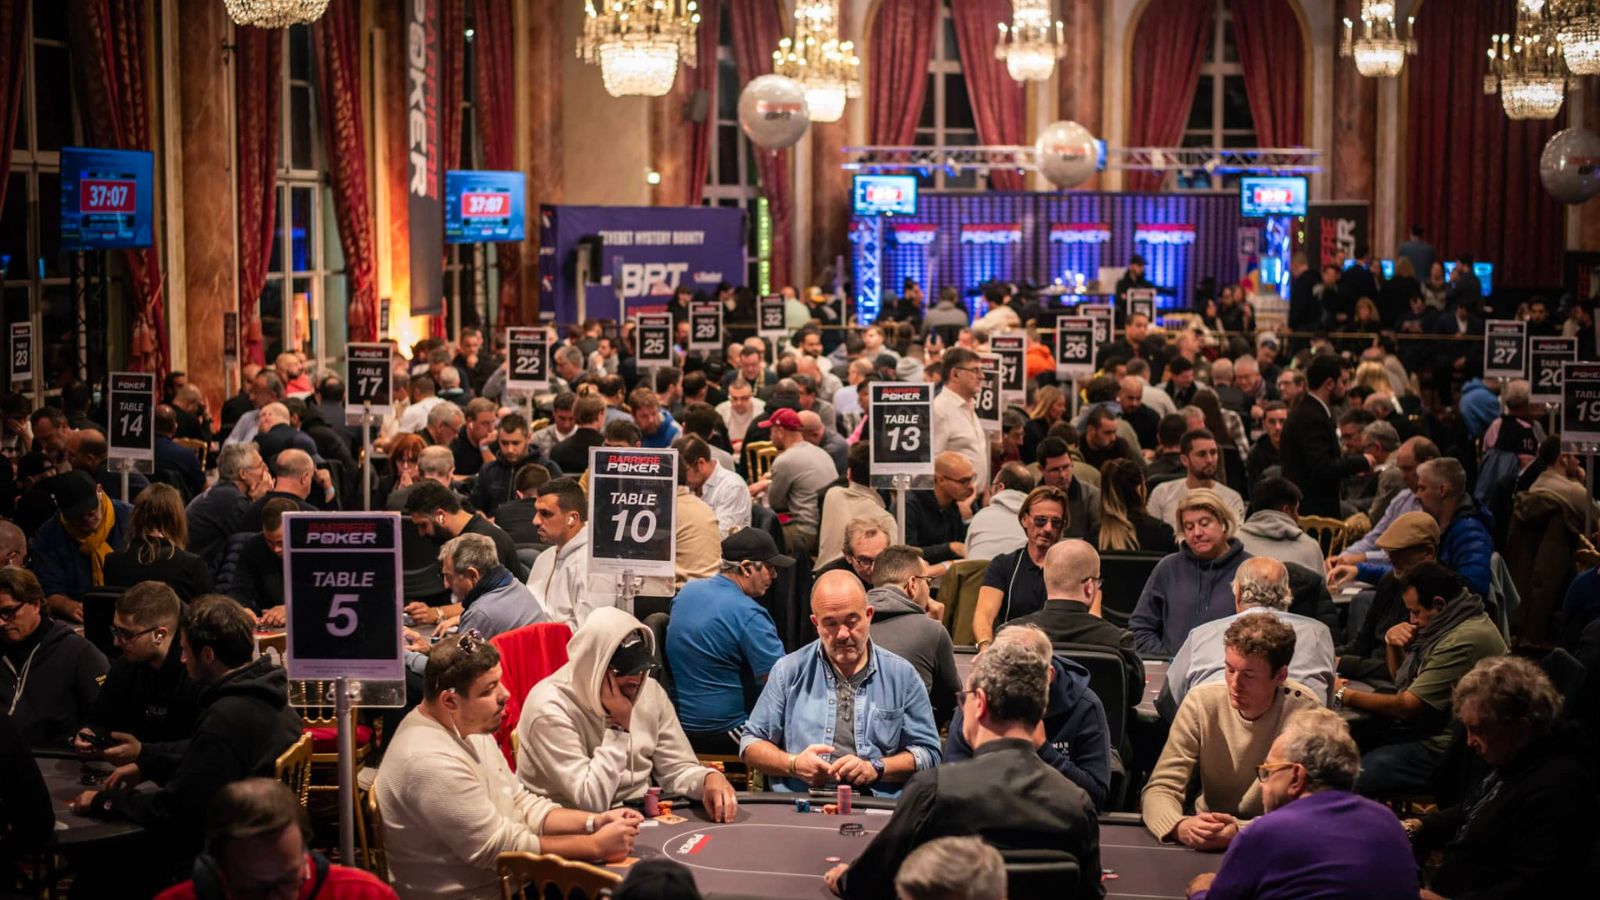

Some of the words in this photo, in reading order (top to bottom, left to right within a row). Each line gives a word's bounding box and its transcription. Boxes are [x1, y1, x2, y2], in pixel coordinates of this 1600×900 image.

[90, 185, 128, 208] 37:07
[696, 325, 716, 338] 29
[516, 348, 539, 356] TABLE
[644, 340, 665, 354] 25
[1064, 343, 1088, 358] 26
[15, 350, 28, 367] 23
[1492, 348, 1518, 364] 27
[356, 367, 382, 376] TABLE
[515, 357, 540, 374] 22
[1572, 371, 1600, 379] POKE
[117, 381, 146, 390] POKER
[358, 377, 383, 397] 17
[880, 392, 921, 401] POKER
[974, 389, 994, 411] 18
[1575, 389, 1600, 399] TABL
[119, 402, 145, 412] TABLE
[1576, 401, 1600, 422] 19
[119, 414, 144, 438] 14
[884, 414, 920, 424] TABLE
[887, 427, 921, 451] 13
[606, 462, 661, 474] POKER
[610, 492, 658, 506] TABLE
[610, 509, 657, 543] 10
[306, 532, 378, 545] POKER
[312, 572, 376, 588] TABLE
[325, 593, 361, 637] 5
